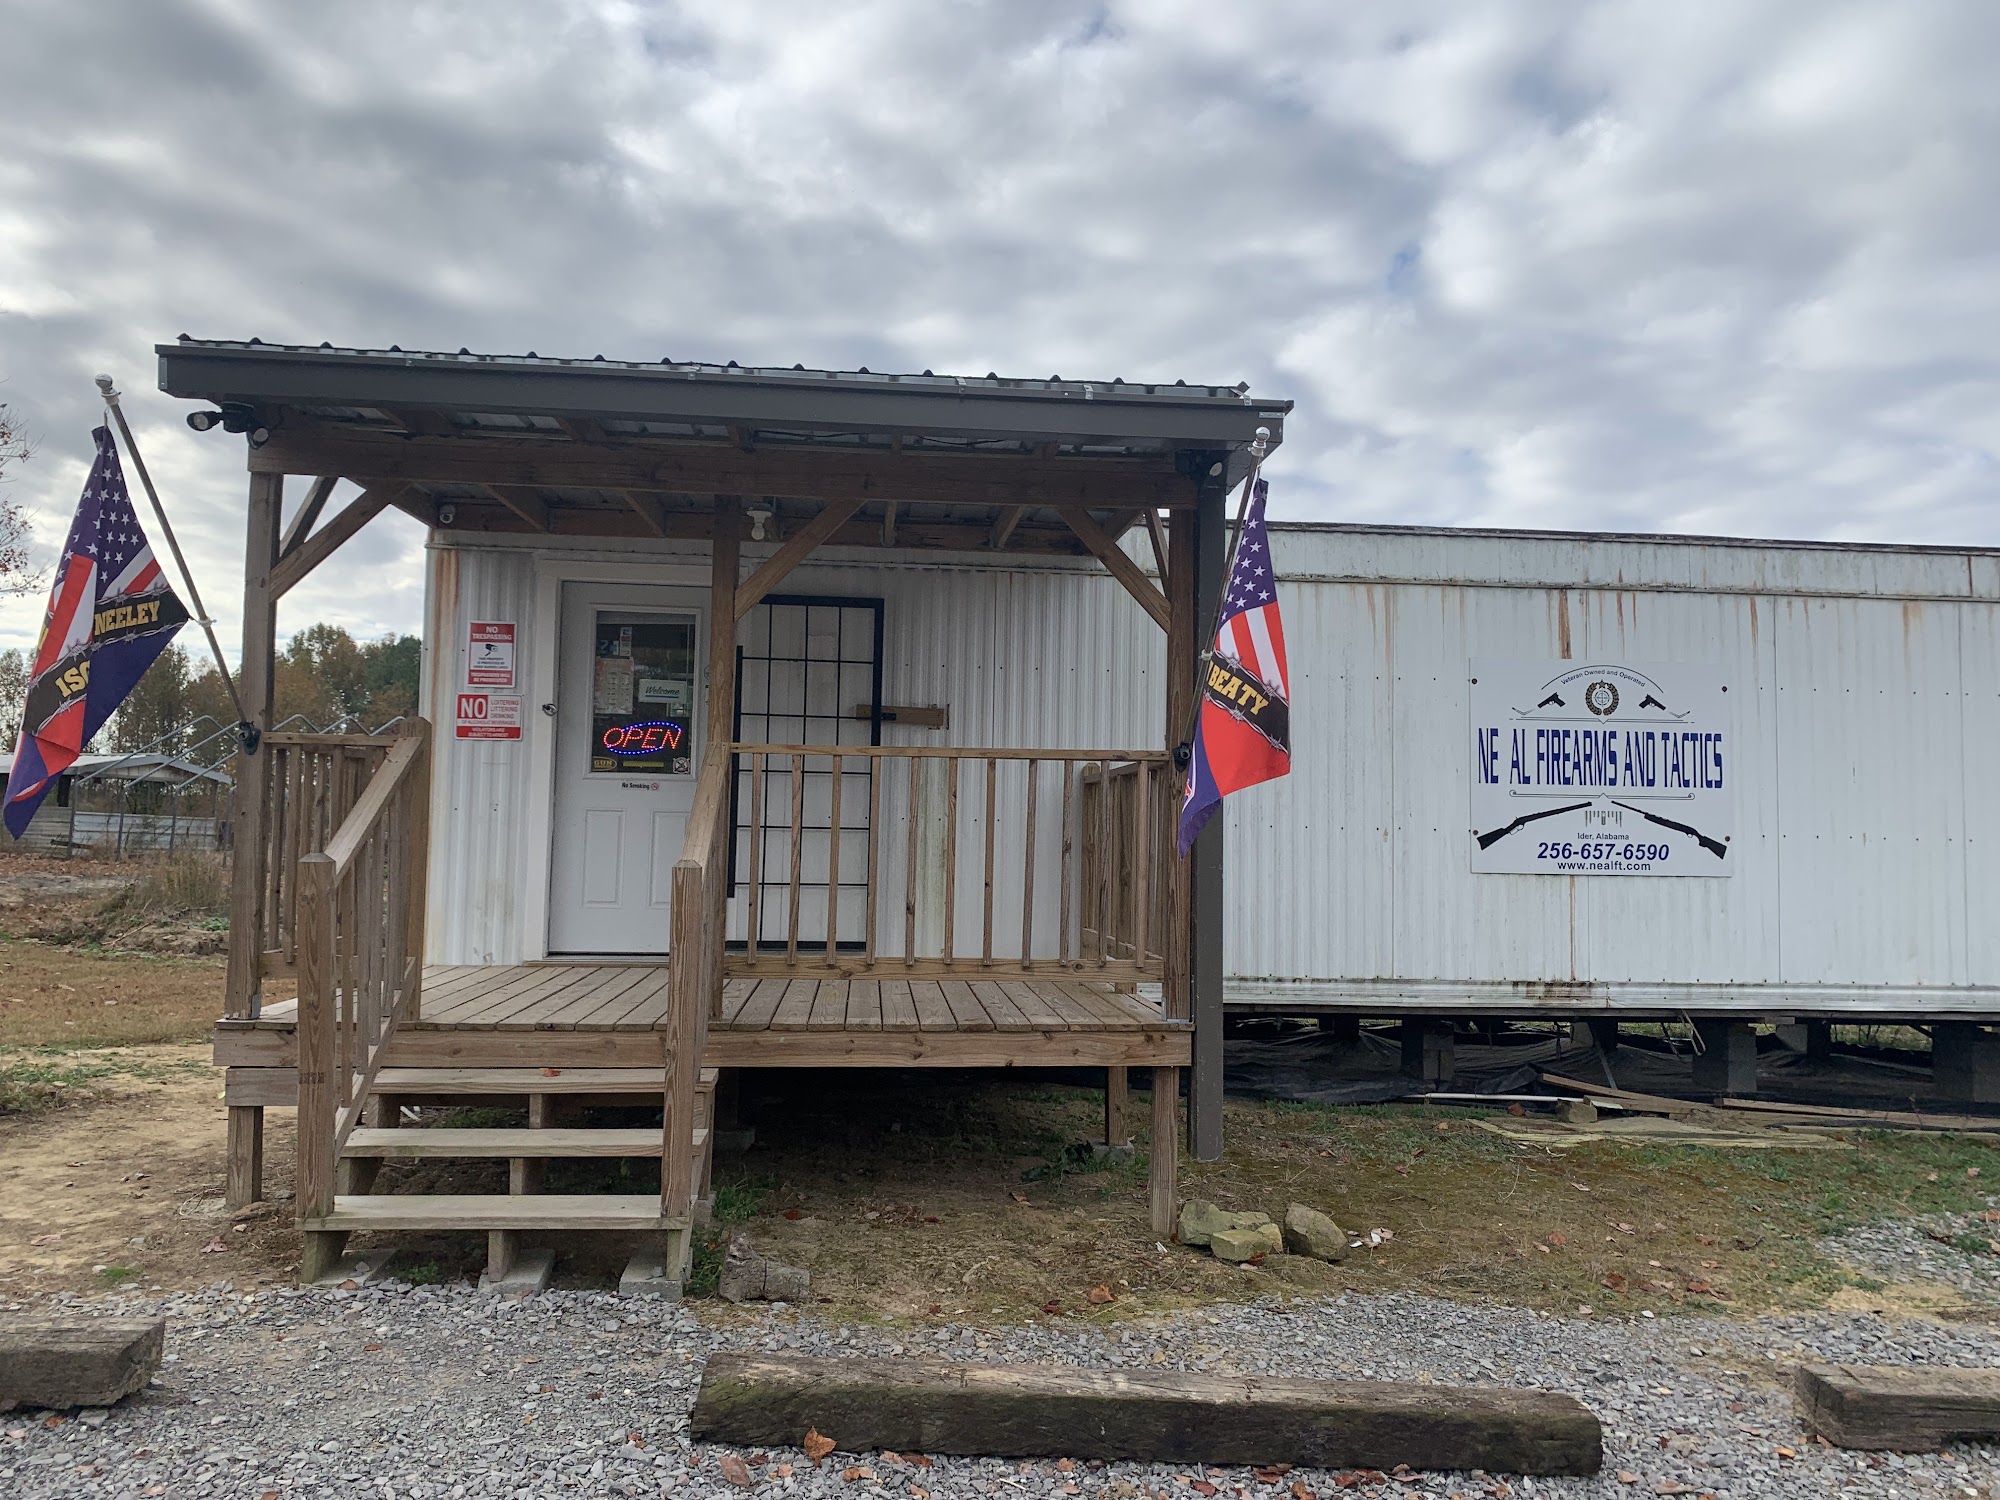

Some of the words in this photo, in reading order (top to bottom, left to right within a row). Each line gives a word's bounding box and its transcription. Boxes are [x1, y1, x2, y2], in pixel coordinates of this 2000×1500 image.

[94, 600, 160, 636] NEELEY
[1561, 672, 1583, 685] Veteran
[1620, 671, 1646, 687] Operated
[645, 686, 680, 695] Welcome
[461, 698, 487, 719] NO
[603, 727, 682, 750] OPEN
[1478, 728, 1499, 784] NE
[1509, 729, 1531, 785] AL
[1537, 729, 1617, 787] FIREARMS
[1623, 731, 1656, 787] AND
[1661, 732, 1723, 789] TACTICS
[1577, 833, 1594, 841] Ider,
[1537, 842, 1670, 861] 256-657-6590
[1557, 861, 1651, 871] www.nealft.com
